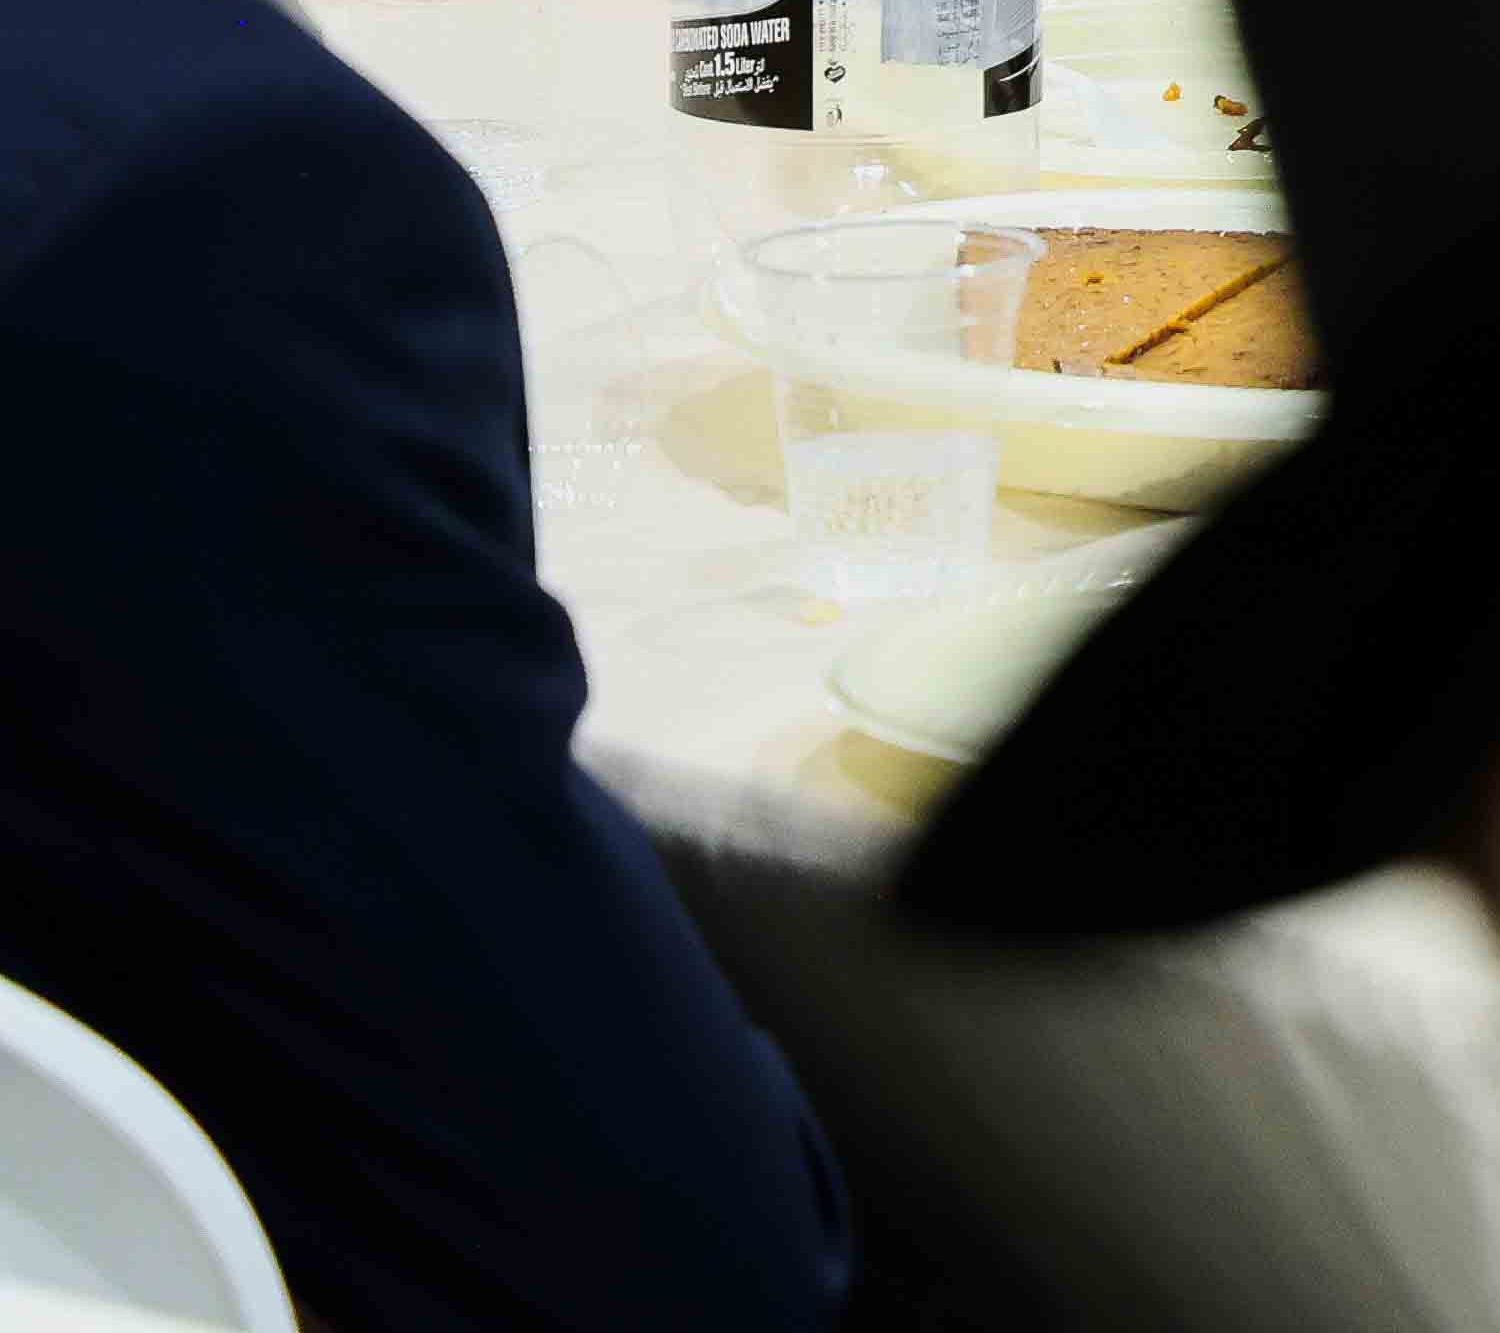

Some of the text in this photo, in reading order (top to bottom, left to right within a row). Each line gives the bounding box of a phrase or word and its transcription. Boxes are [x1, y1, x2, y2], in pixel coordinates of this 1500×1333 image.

[720, 22, 749, 49] SODA
[750, 17, 790, 45] WATER
[714, 51, 736, 77] 1.5
